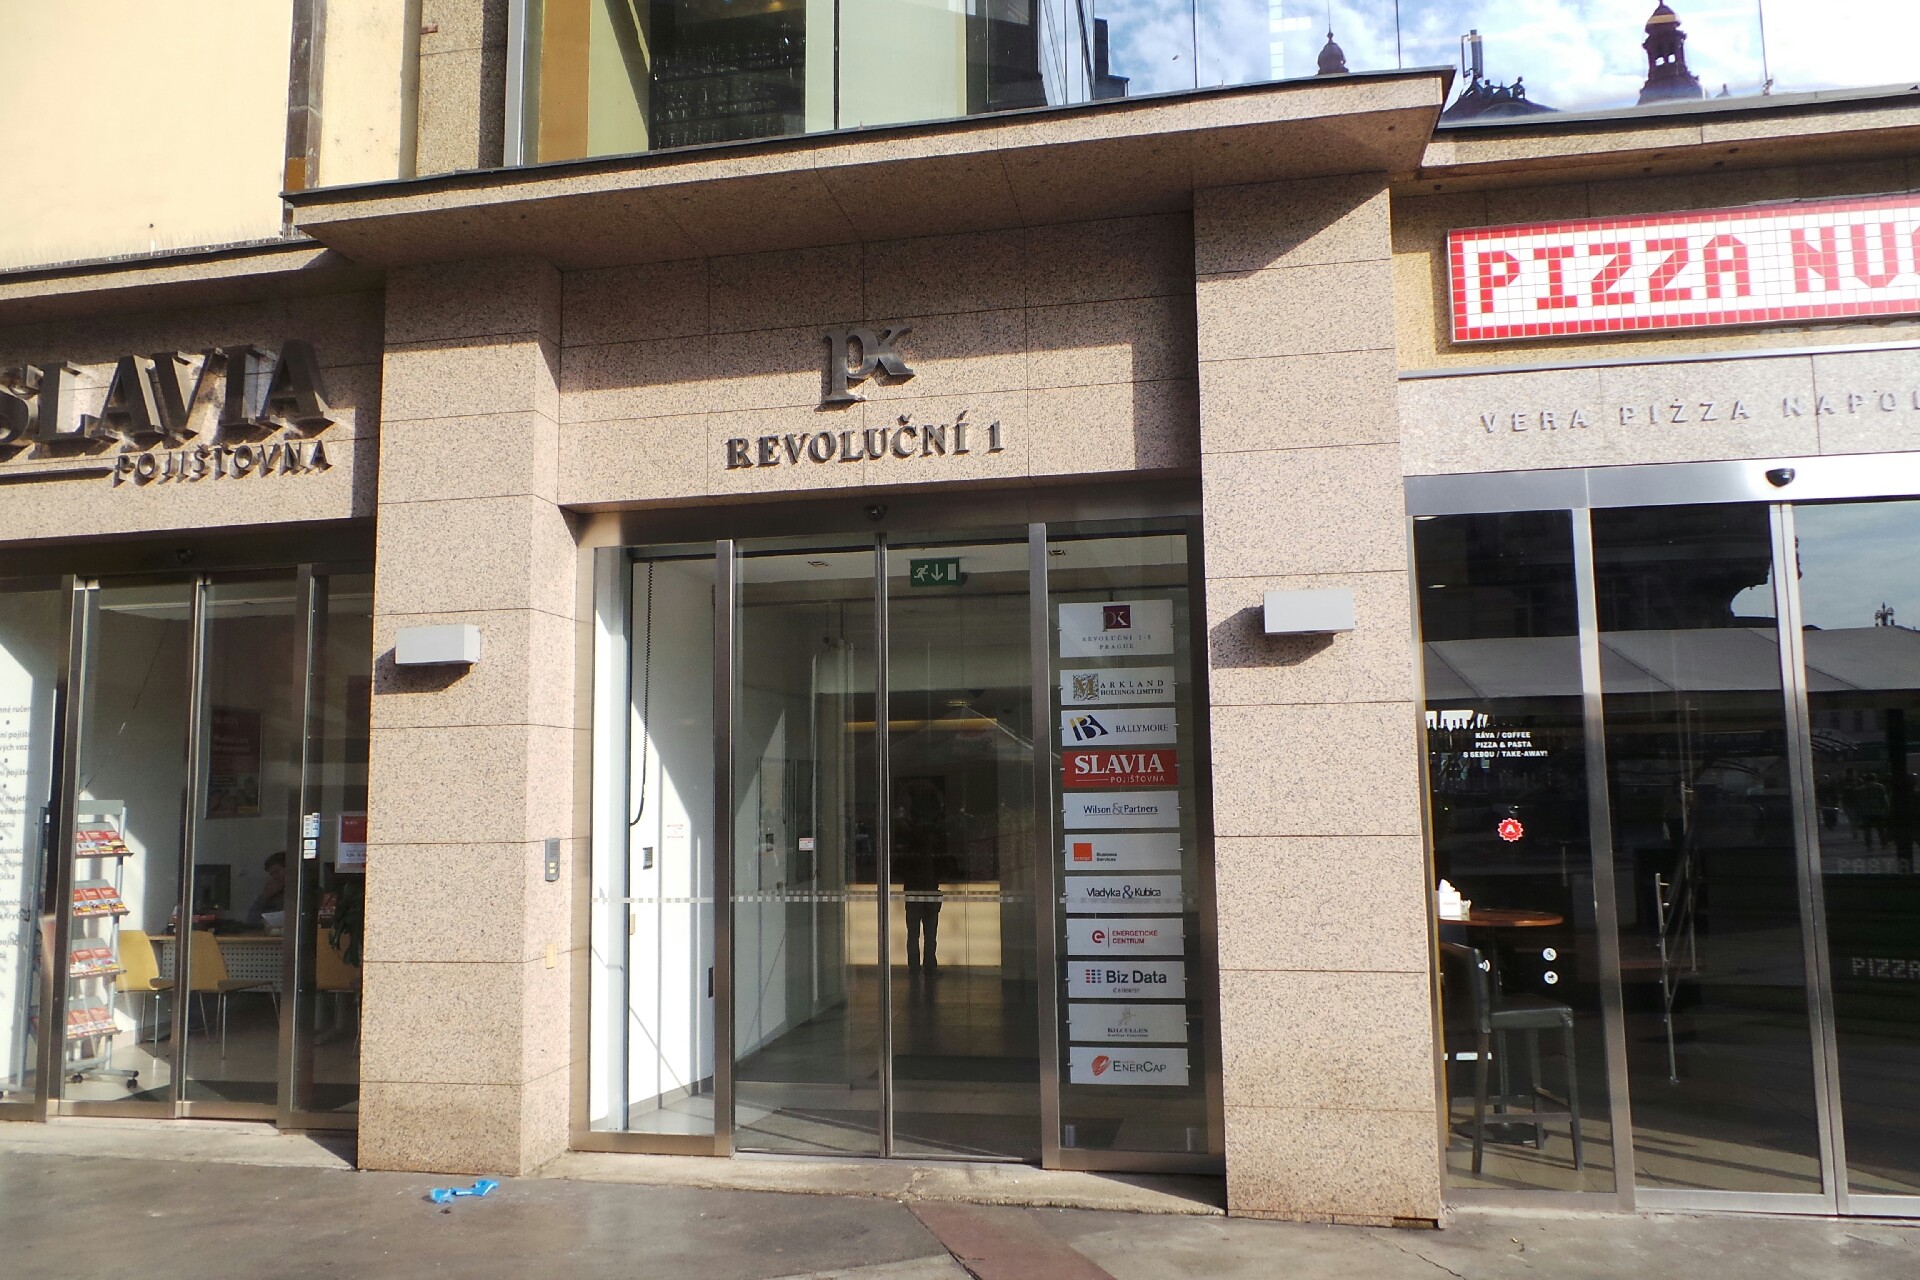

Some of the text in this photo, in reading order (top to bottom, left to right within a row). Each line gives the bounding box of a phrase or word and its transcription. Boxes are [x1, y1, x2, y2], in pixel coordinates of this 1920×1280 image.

[1478, 220, 1920, 313] PIZZA NU
[1482, 409, 1588, 432] VERA
[1620, 401, 1751, 425] PIZZA
[726, 411, 1004, 468] REVOLUČNÍ 1
[1115, 724, 1169, 733] BALLYMORE
[1475, 731, 1495, 739] KÁVA
[1501, 731, 1531, 739] COFFEE
[1507, 740, 1532, 748] PASTA
[1075, 753, 1165, 775] SLAVIA
[1084, 803, 1158, 816] Wilson & Partners
[1086, 885, 1162, 899] Vladyka & Kubica
[1111, 929, 1158, 937] ENERGETICKÉ
[1106, 970, 1167, 984] Biz Data
